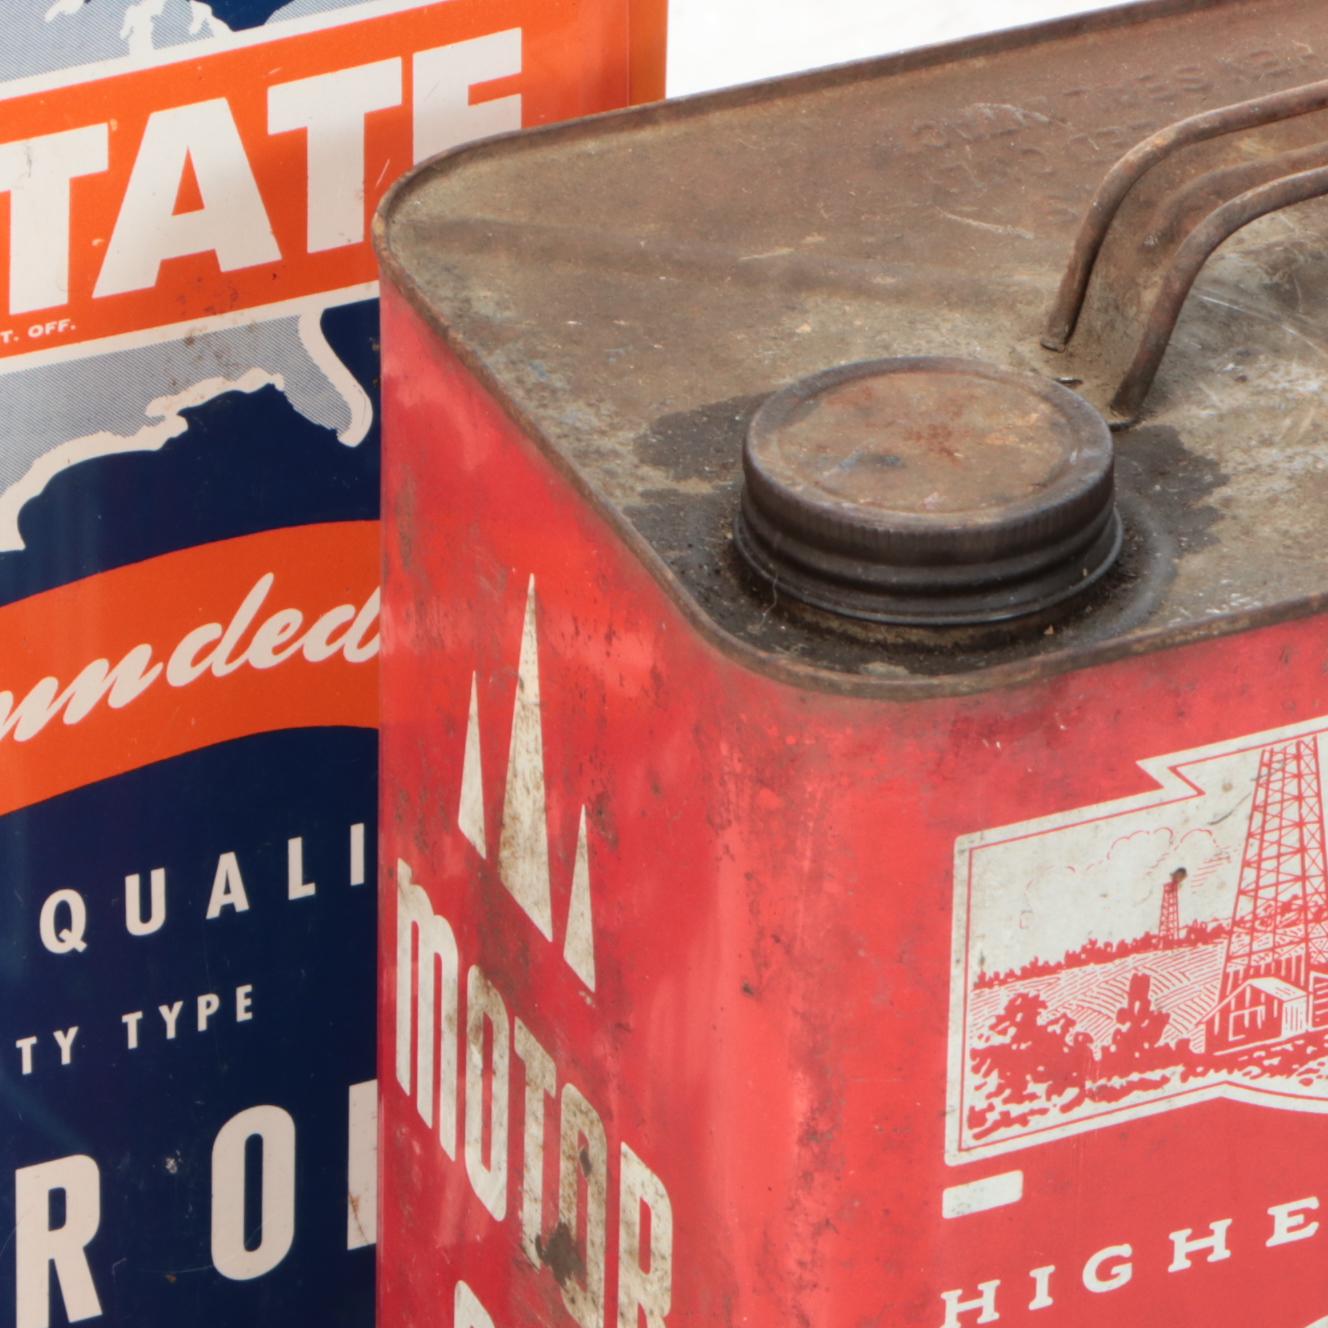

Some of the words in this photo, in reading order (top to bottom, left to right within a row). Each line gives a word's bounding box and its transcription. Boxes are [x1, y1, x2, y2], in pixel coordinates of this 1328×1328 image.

[27, 318, 76, 339] OFF.
[38, 822, 366, 954] QUALI
[120, 982, 254, 1051] TYPE
